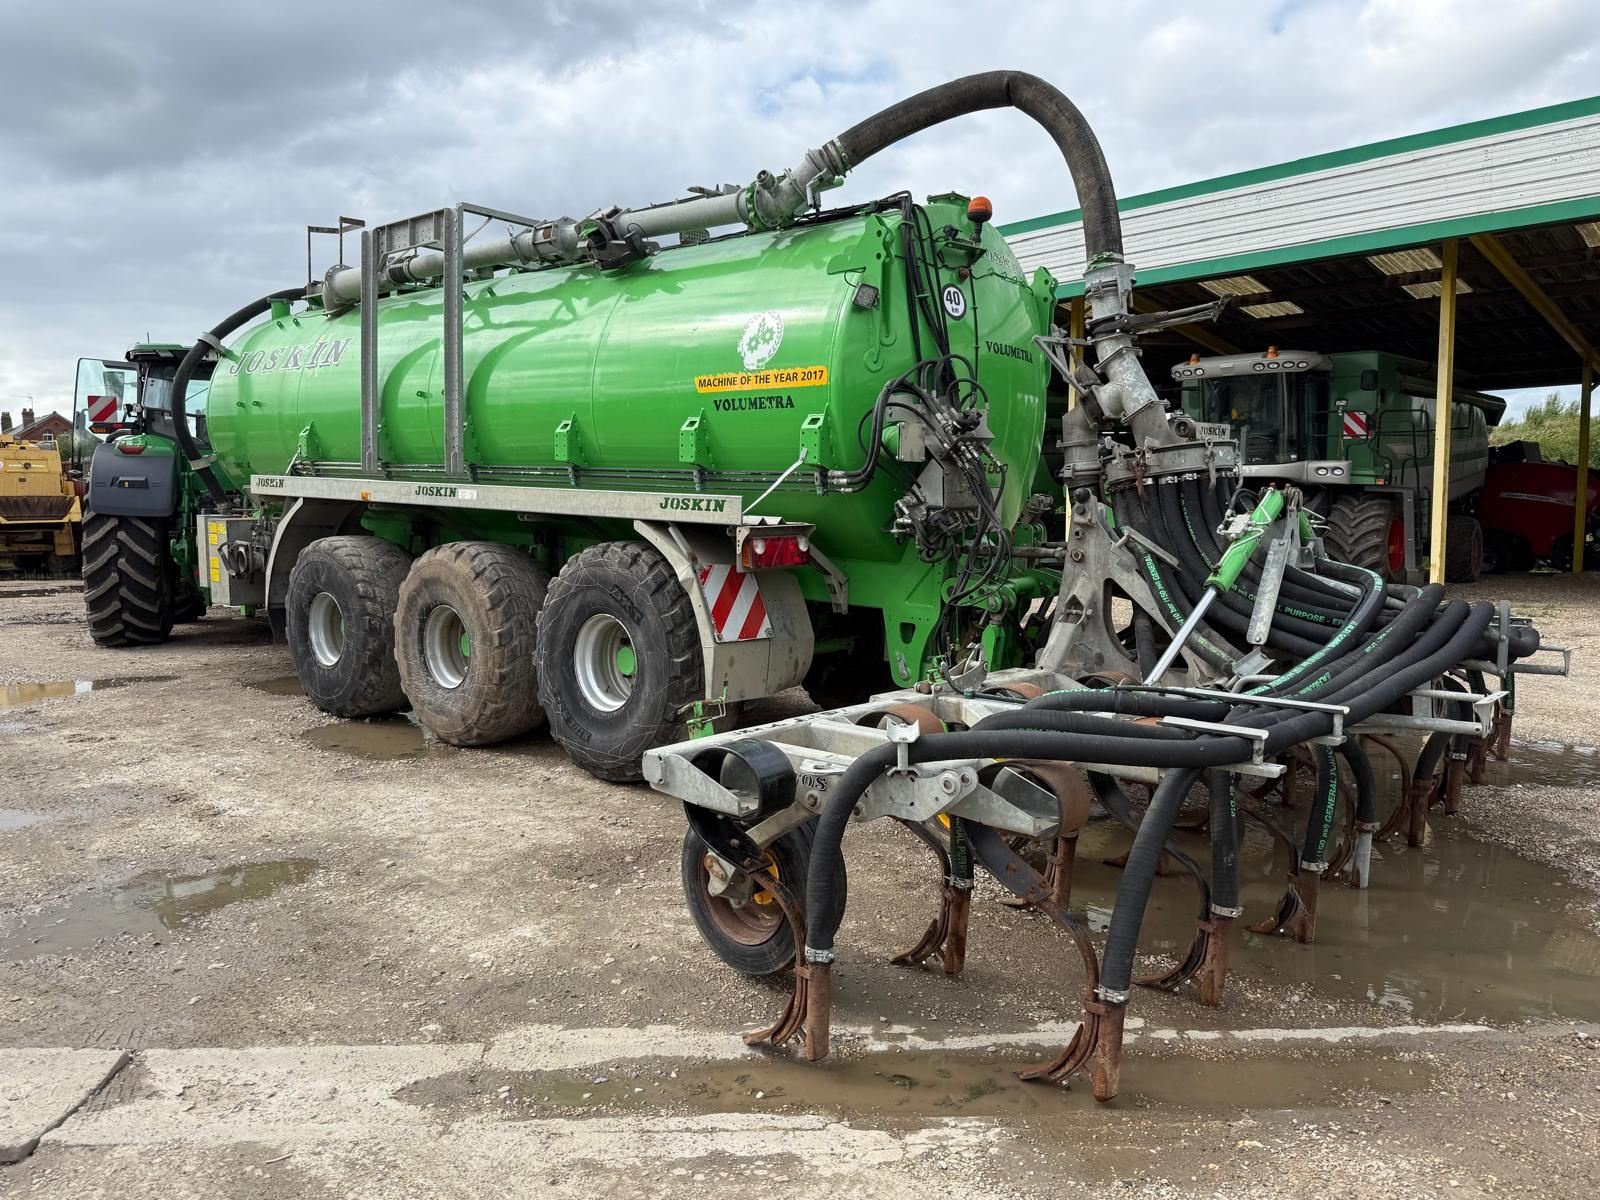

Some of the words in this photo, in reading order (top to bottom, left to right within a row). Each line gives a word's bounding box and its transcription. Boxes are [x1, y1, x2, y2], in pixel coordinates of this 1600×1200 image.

[945, 290, 961, 305] 40
[229, 337, 352, 376] JOSKIN
[985, 340, 1033, 364] VOLUMETRA
[698, 376, 738, 388] MACHINE
[740, 375, 752, 385] OF
[754, 374, 771, 384] THE
[774, 372, 798, 383] YEAR
[800, 370, 824, 381] 2017
[713, 395, 795, 412] VOLUMETRA
[256, 477, 284, 488] JOSKIN
[415, 485, 457, 497] JOSKIN
[659, 497, 726, 513] JOSKIN
[1284, 606, 1326, 623] PURPOSE
[1324, 778, 1337, 823] GENERAL
